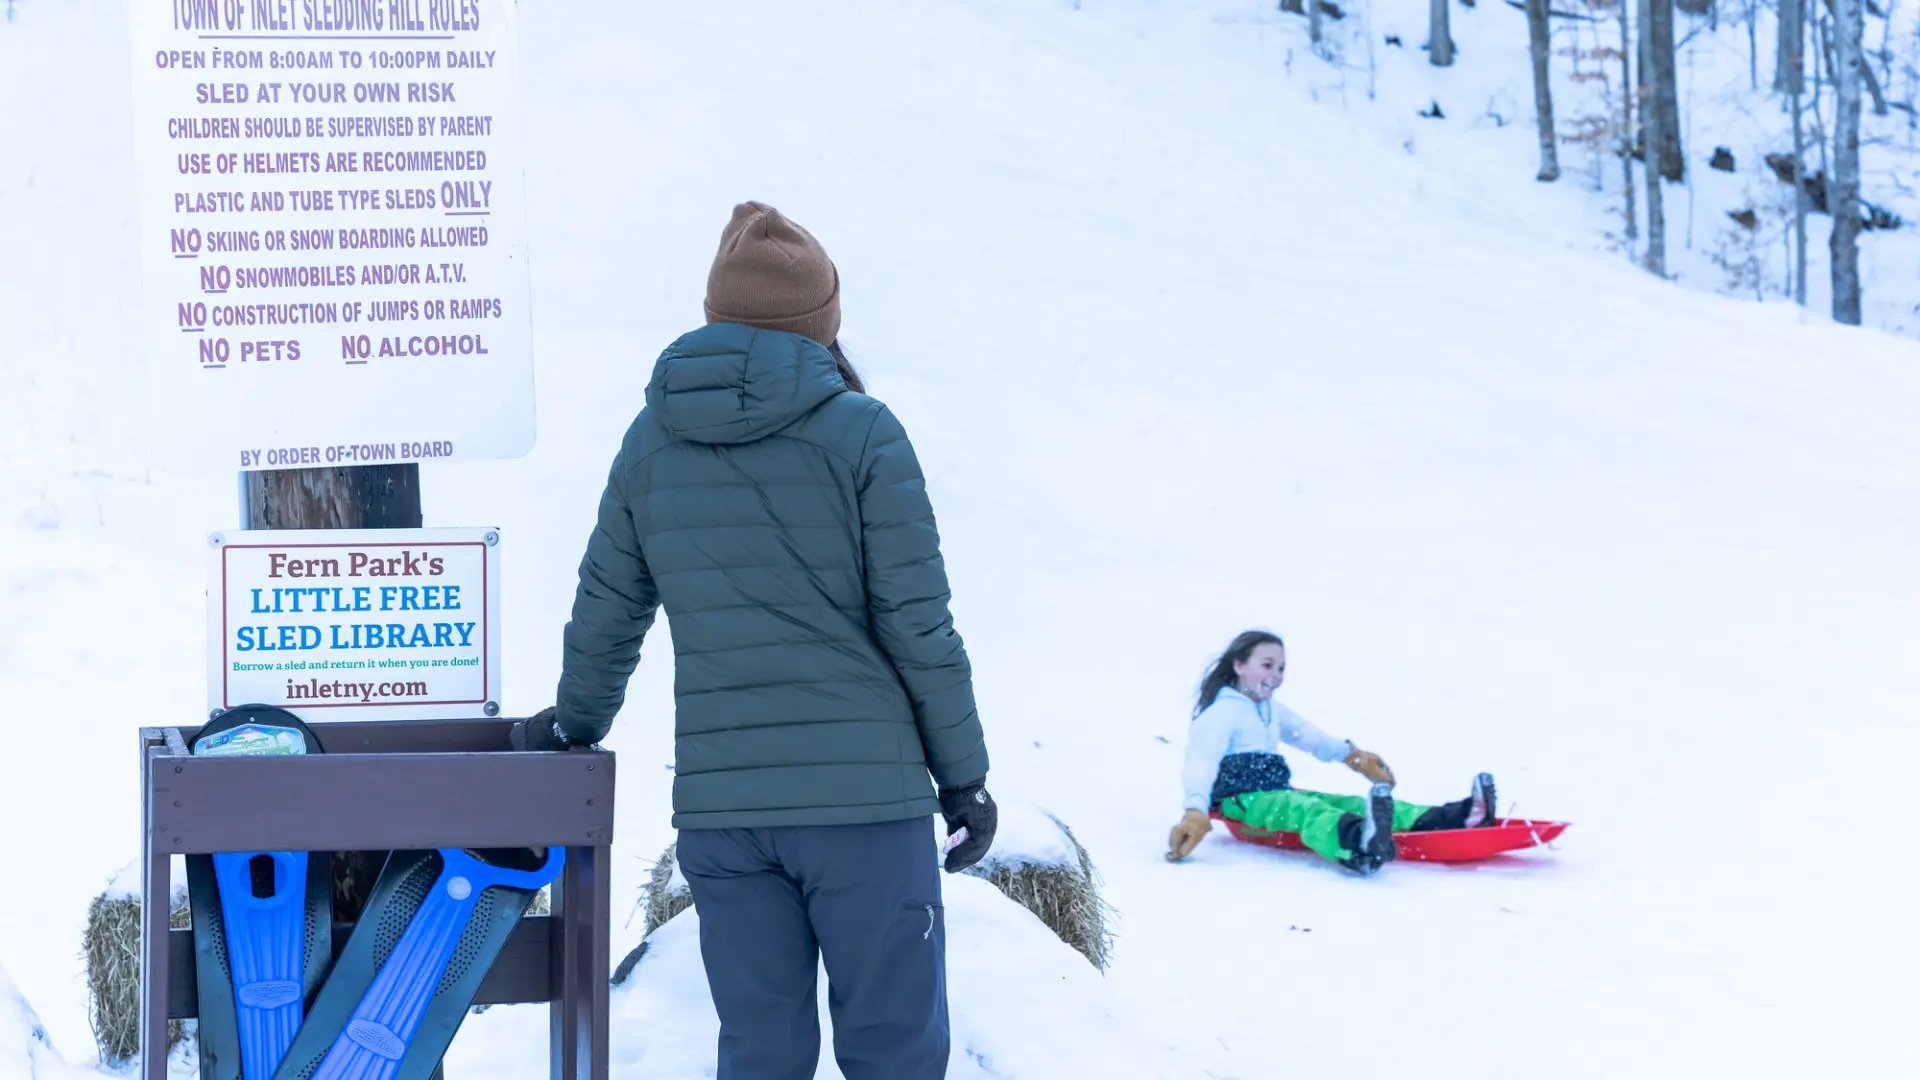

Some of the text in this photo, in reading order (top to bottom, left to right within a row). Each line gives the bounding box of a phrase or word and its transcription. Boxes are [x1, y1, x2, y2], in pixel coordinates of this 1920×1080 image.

[174, 0, 479, 31] TOWN OF INLET SLEDDING HILL RULES
[156, 51, 496, 68] OPEN FROM 8:00AM TO 10:00PM DAILY
[197, 83, 455, 103] SLED AT YOUR OWN RISK
[168, 116, 492, 138] CHILDREN SHOULD BE SUPERVISED BY PARENT
[178, 151, 486, 174] USE OF HELMETS ARE RECOMMENDED
[175, 181, 492, 212] PLASTIC AND TUBE TYPE SLEDS ONLY
[171, 227, 488, 252] NO SKIING OR SNOW BOARDING ALLOWED
[200, 263, 466, 289] NO SNOWMOBILES AND/OR A.T.V.
[178, 298, 501, 326] NO CONSTRUCTION OF JUMPS OR RAMPS
[199, 338, 300, 362] NO PETS
[342, 335, 488, 362] NO ALCOHOL
[241, 441, 453, 467] BY ORDER OF TOWN BOARD
[268, 551, 444, 578] Fern Park's
[251, 585, 461, 613] LITTLE FREE
[236, 622, 476, 651] SLED LIBRARY
[233, 661, 274, 671] Borrow
[285, 660, 306, 670] sled
[308, 660, 328, 669] and
[331, 660, 365, 669] return
[367, 659, 375, 668] it
[378, 658, 407, 668] when
[409, 659, 429, 669] you
[431, 659, 449, 667] are
[450, 656, 479, 666] done!
[286, 678, 428, 702] inletny.com
